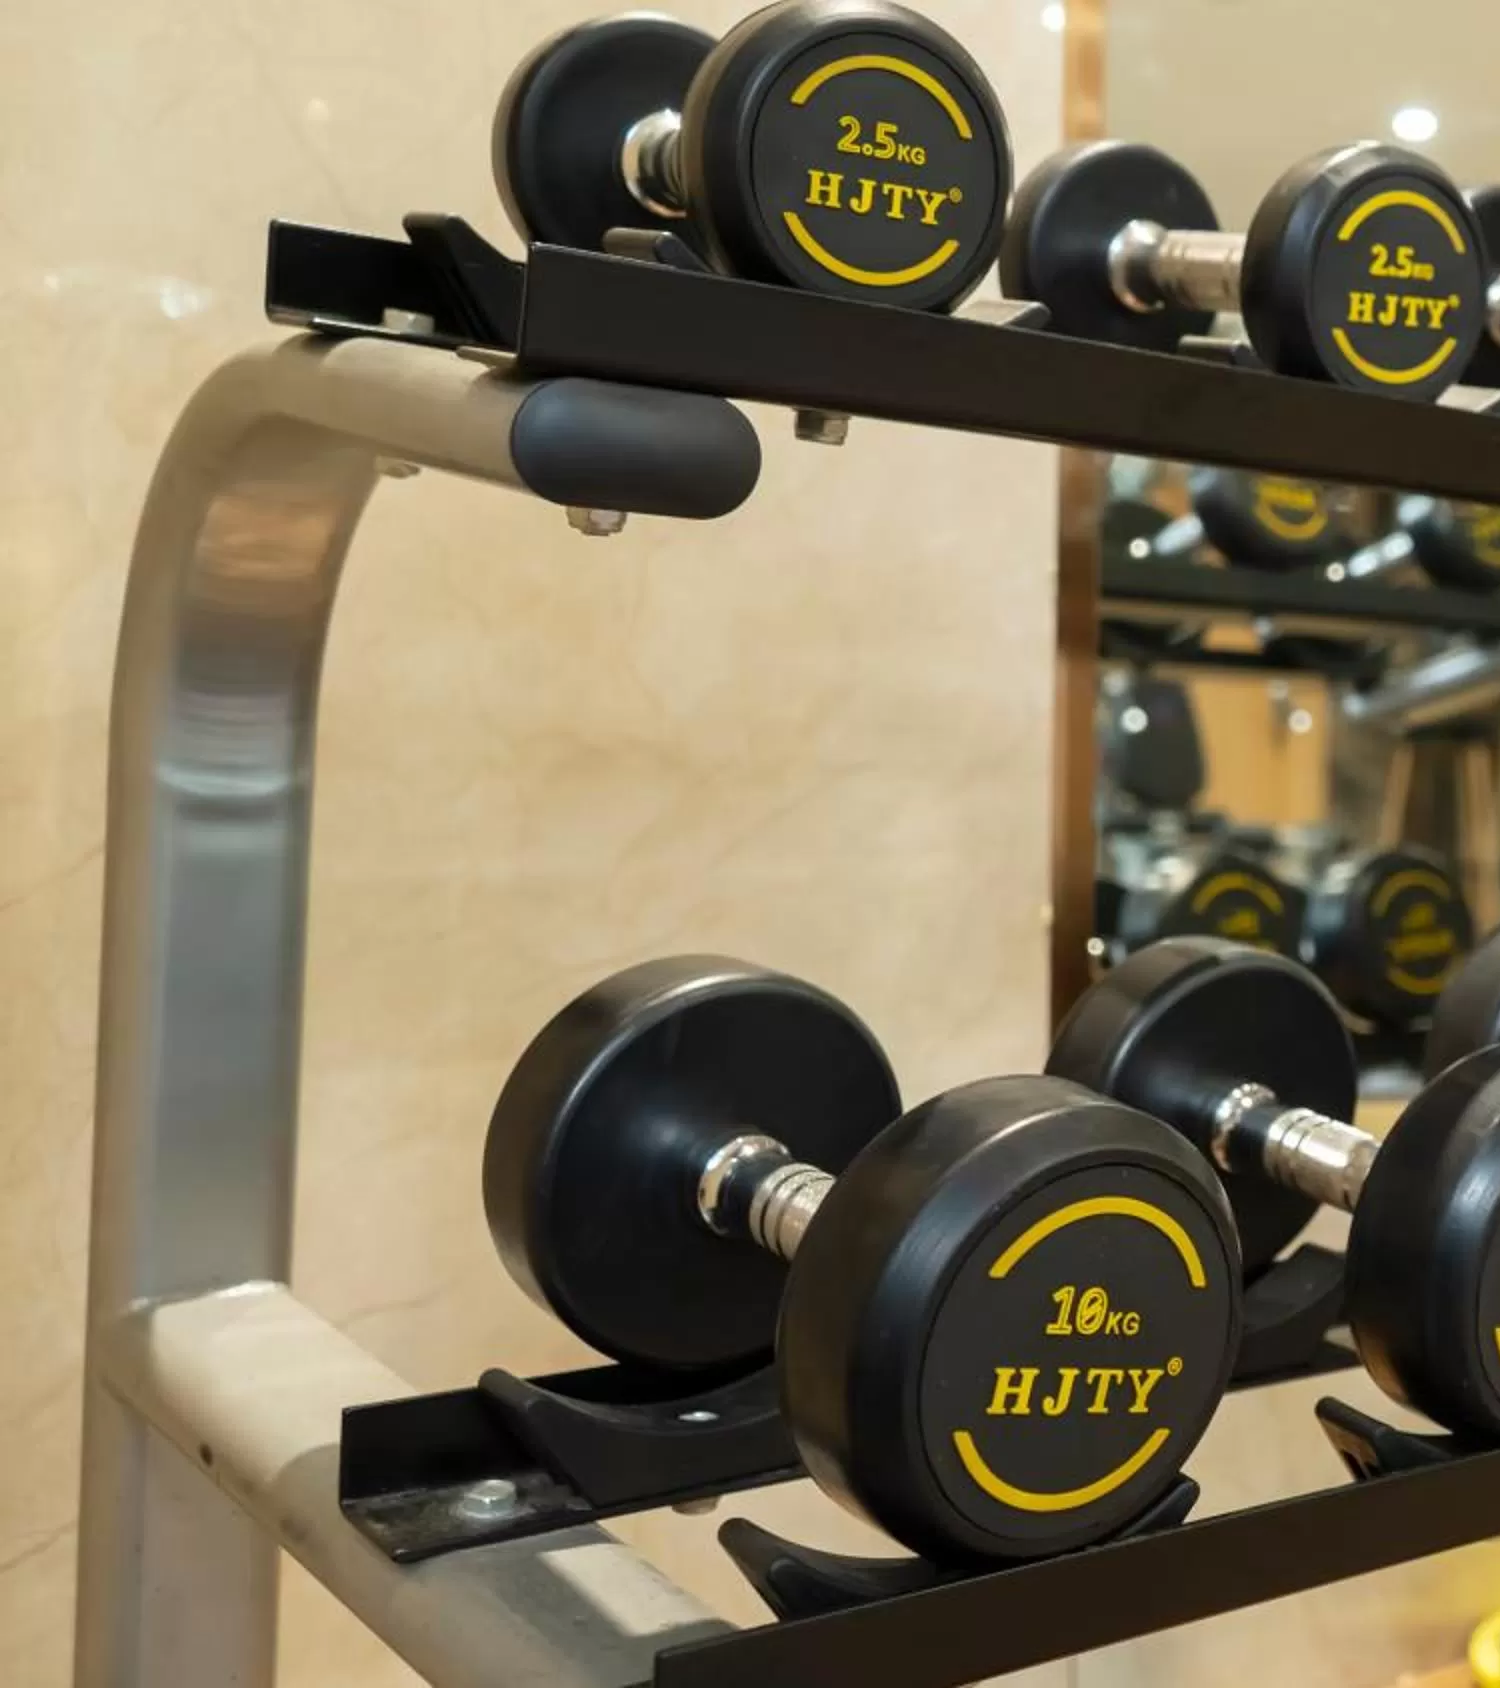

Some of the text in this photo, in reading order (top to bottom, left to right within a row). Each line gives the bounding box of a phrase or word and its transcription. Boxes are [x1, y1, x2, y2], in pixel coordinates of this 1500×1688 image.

[836, 115, 926, 165] 2.5KG
[805, 169, 947, 225] HJTY
[1347, 290, 1448, 329] HJTY
[1046, 1286, 1141, 1335] 10KG
[986, 1367, 1164, 1416] HJTY
